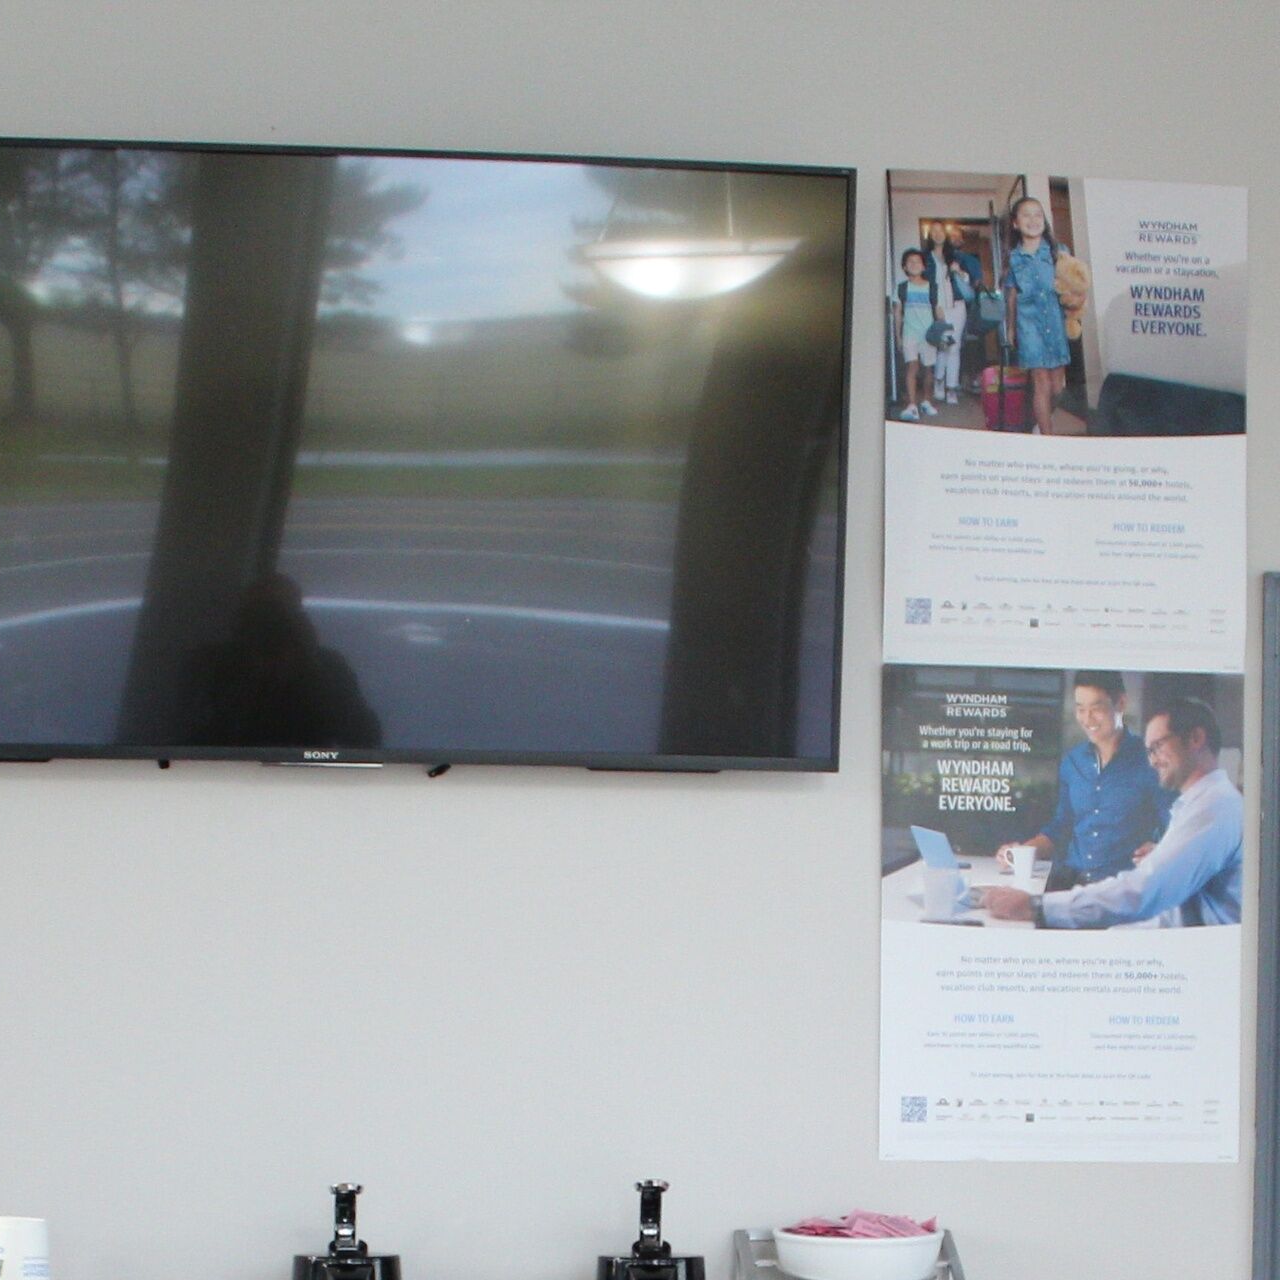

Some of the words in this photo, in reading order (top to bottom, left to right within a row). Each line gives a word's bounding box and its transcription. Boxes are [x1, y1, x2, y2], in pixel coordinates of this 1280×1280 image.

[1139, 221, 1198, 231] WYNDHAM
[1139, 233, 1198, 245] REWARDS
[1130, 285, 1205, 302] WYNDHAM
[1134, 302, 1201, 319] REWARDS
[1131, 319, 1207, 337] EVERYONE.
[946, 694, 1007, 704] WYNDHAM
[946, 707, 1007, 718] REWARDS
[919, 725, 956, 736] Whether
[958, 727, 985, 739] you're
[988, 727, 1019, 739] staying
[1021, 727, 1033, 738] for
[923, 740, 928, 748] a
[930, 739, 952, 749] work
[954, 739, 969, 751] trip
[972, 741, 981, 749] or
[983, 741, 989, 749] a
[991, 740, 1011, 750] road
[1013, 741, 1031, 752] trip,
[304, 751, 338, 759] SONY
[937, 759, 1014, 776] WYNDHAM
[942, 777, 1010, 794] REWARDS
[939, 795, 1016, 812] EVERYONE.
[955, 1014, 975, 1024] HOW
[978, 1014, 989, 1024] TO
[991, 1014, 1015, 1024] EARN
